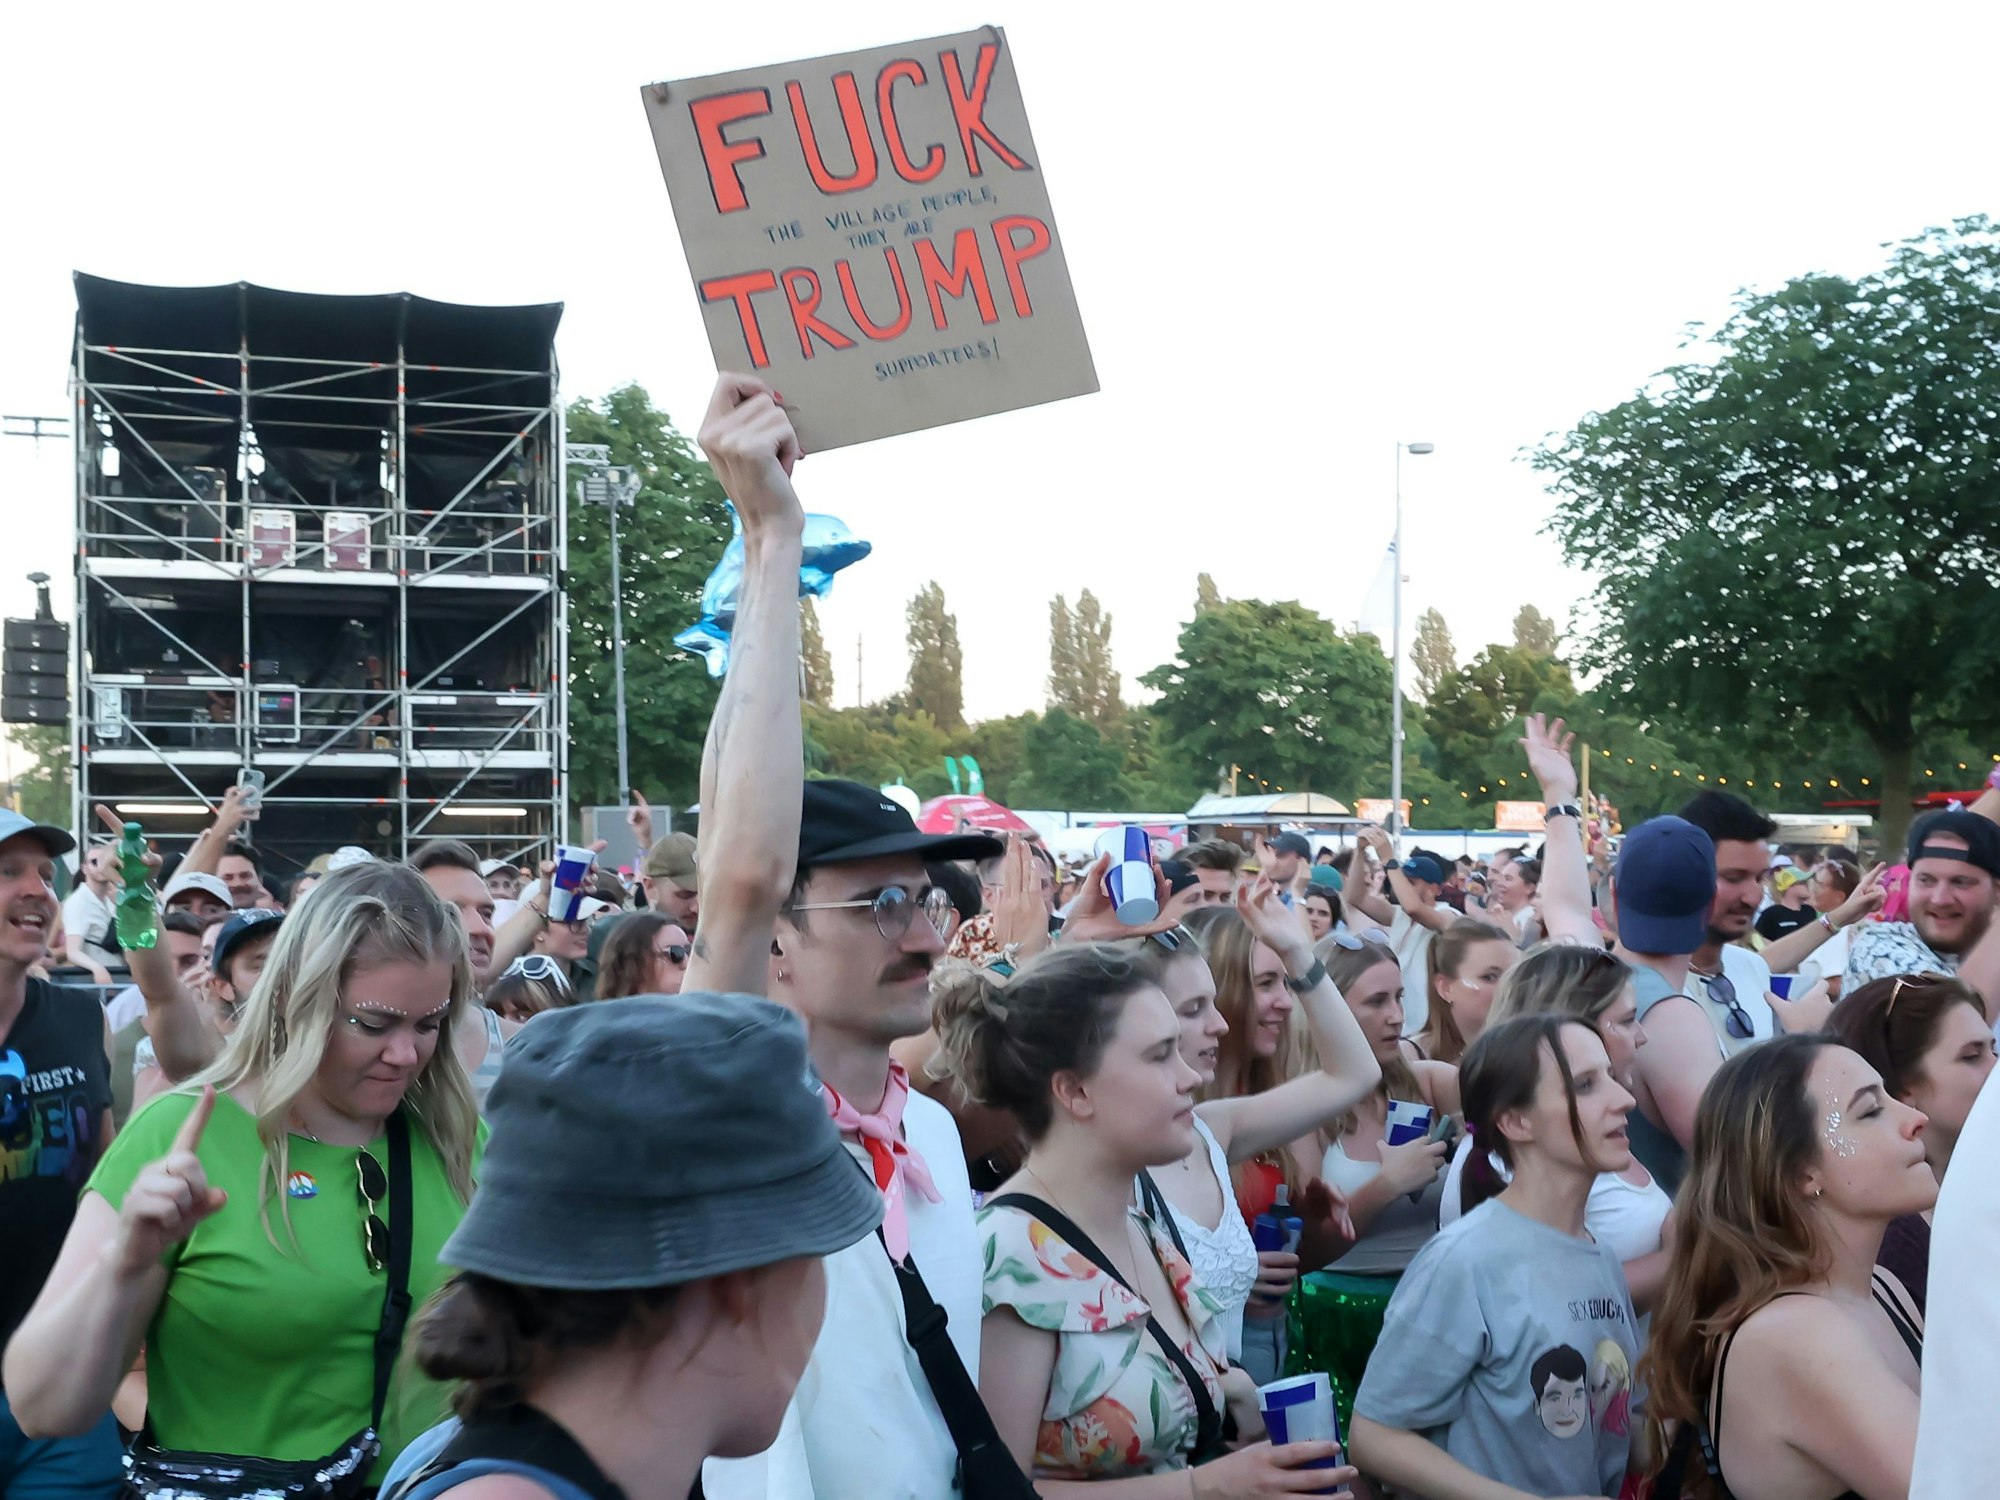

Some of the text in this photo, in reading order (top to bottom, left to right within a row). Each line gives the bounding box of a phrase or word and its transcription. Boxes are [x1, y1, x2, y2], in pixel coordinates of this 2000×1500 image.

[688, 42, 1035, 216] FUCK
[763, 219, 805, 246] THE
[825, 202, 911, 232] VILLAGE
[847, 215, 934, 250] THEY ARE
[699, 213, 1052, 370] TRUMP
[20, 1065, 75, 1096] FIRST
[1567, 1299, 1590, 1322] SEX
